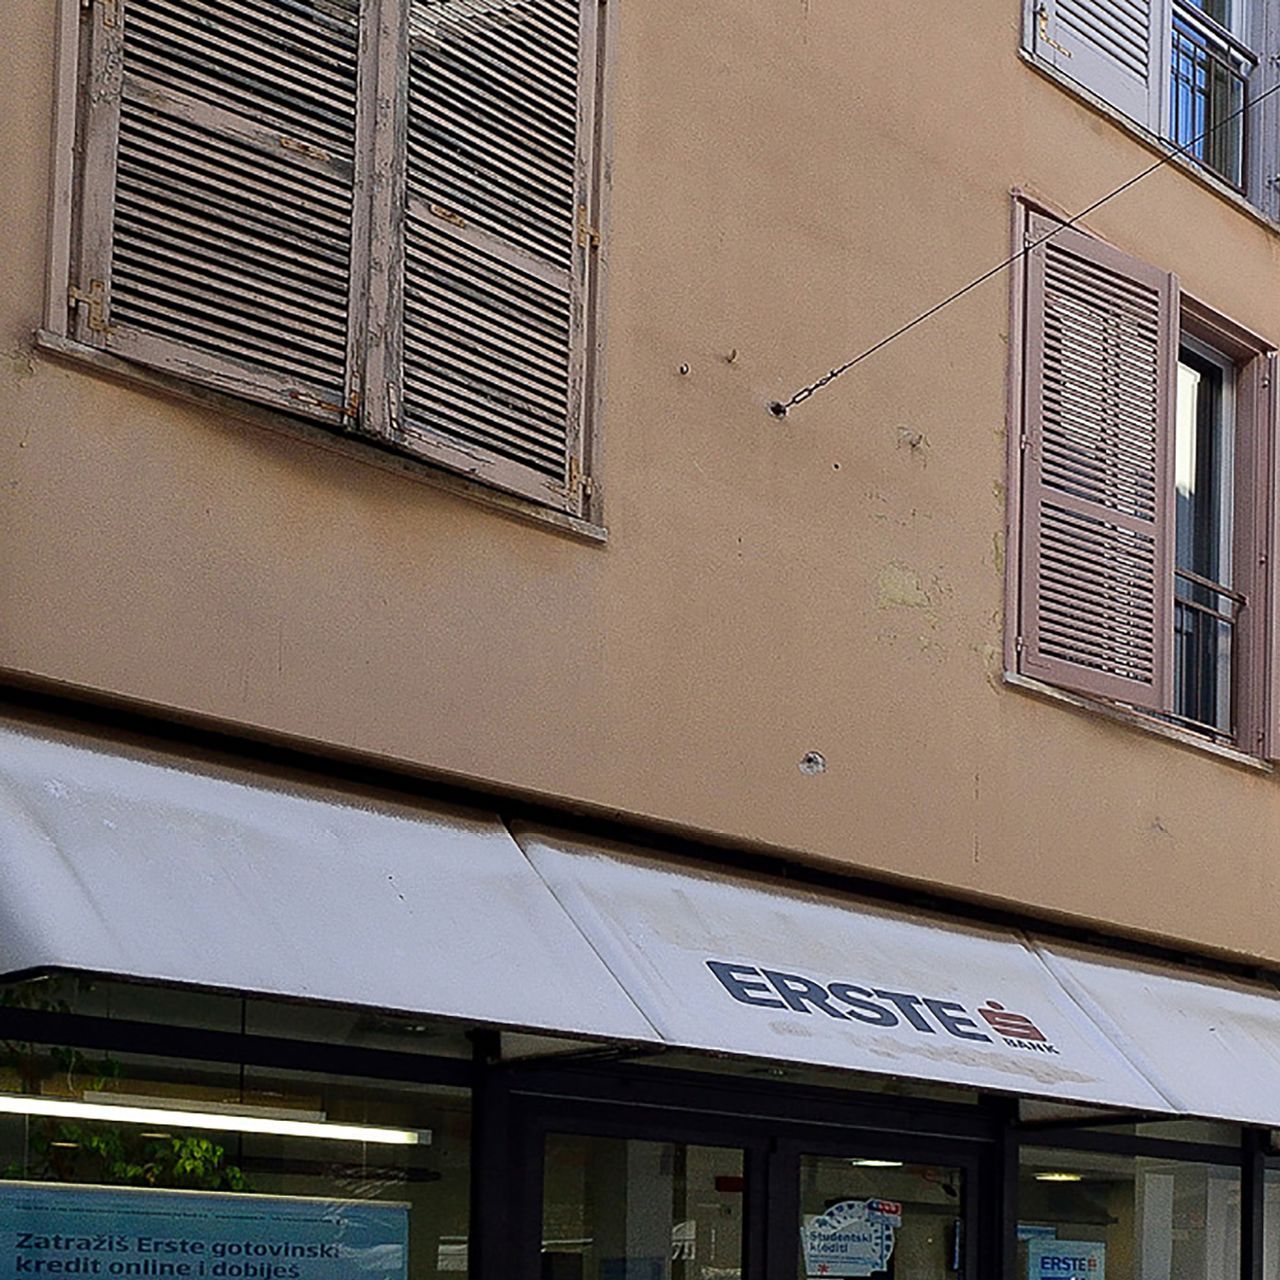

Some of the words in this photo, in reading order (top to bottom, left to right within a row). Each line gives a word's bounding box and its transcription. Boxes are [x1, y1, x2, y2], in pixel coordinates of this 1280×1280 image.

[706, 961, 993, 1043] ERSTE
[1002, 1037, 1060, 1055] BANK
[15, 1232, 129, 1253] Zatražiš
[136, 1236, 205, 1255] Erste
[211, 1238, 343, 1260] gotovinski
[809, 1231, 873, 1244] Studentski
[15, 1255, 101, 1275] kredit
[108, 1258, 196, 1277] online
[1040, 1256, 1086, 1272] ERSTE
